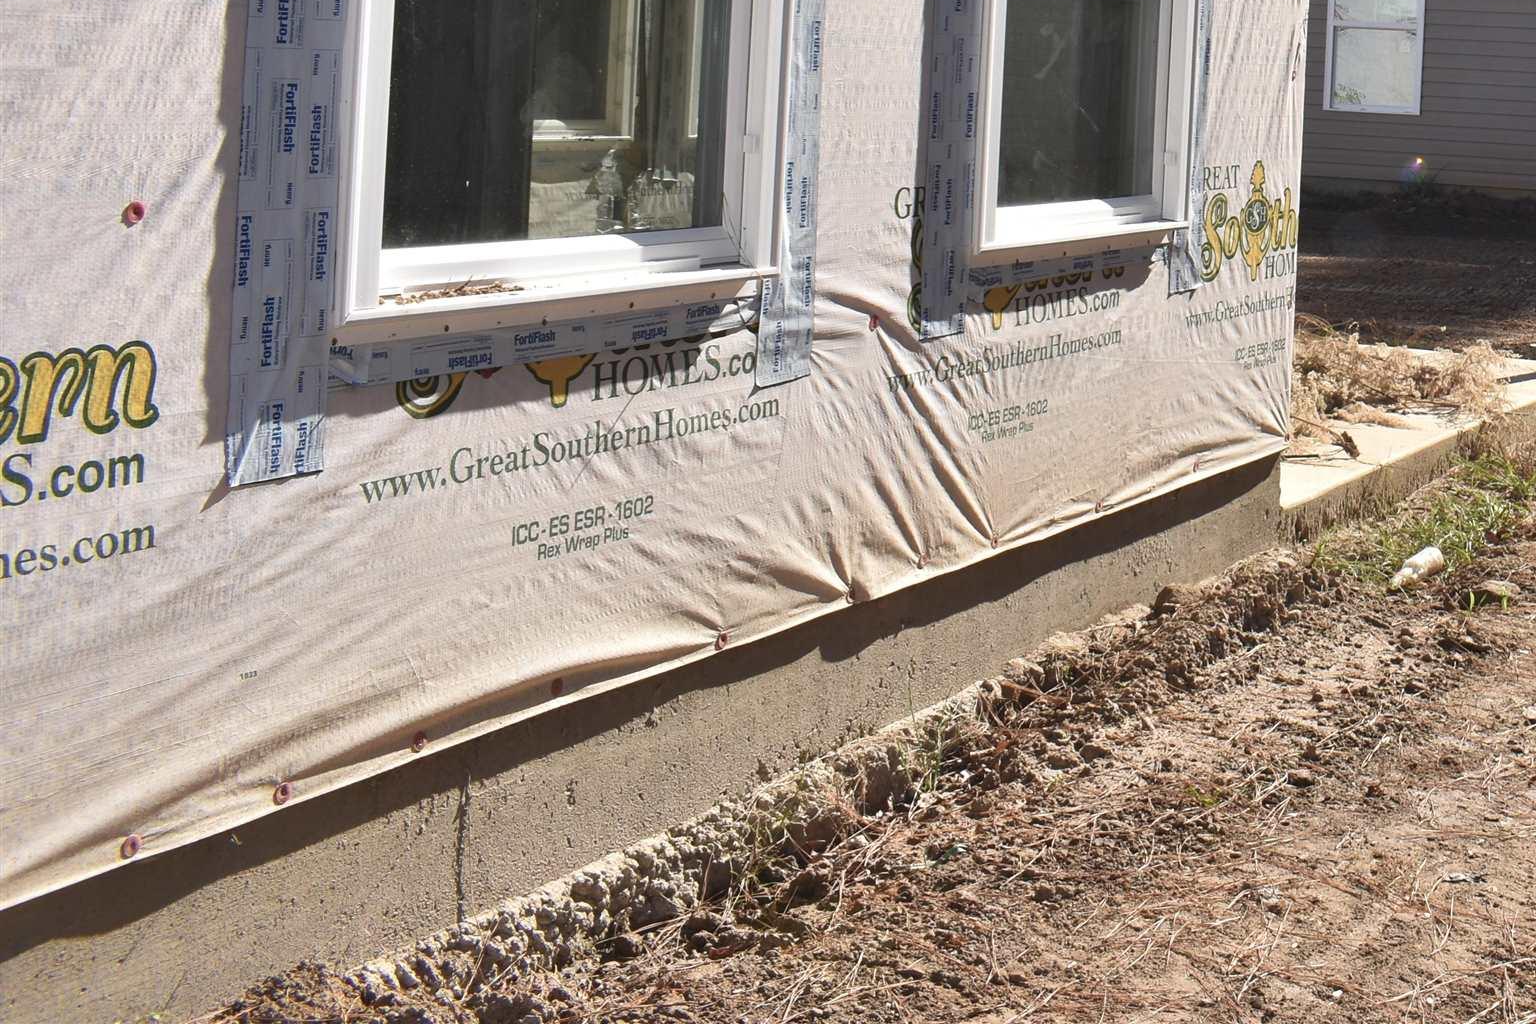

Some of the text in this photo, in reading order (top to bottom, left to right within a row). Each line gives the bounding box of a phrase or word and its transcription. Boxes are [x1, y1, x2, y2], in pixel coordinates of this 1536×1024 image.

[283, 83, 298, 153] FortiFlash
[309, 105, 322, 174] FortiFlash
[238, 215, 252, 287] FortiFlash
[316, 211, 329, 280] FortiFlash
[261, 295, 275, 367] FortiFlash
[514, 329, 556, 346] FortiFlash
[1014, 286, 1120, 327] HOMES.com
[0, 340, 160, 446] rn
[449, 352, 493, 369] FortiFlash
[592, 345, 756, 401] HOMES.co
[887, 328, 1122, 393] www.GreatSouthernHomes.com
[269, 403, 283, 474] FortiFlash
[360, 394, 780, 504] www.GreatSouthernHomes.com
[0, 452, 145, 506] S.com
[537, 527, 629, 560] Rex Wrap Plus
